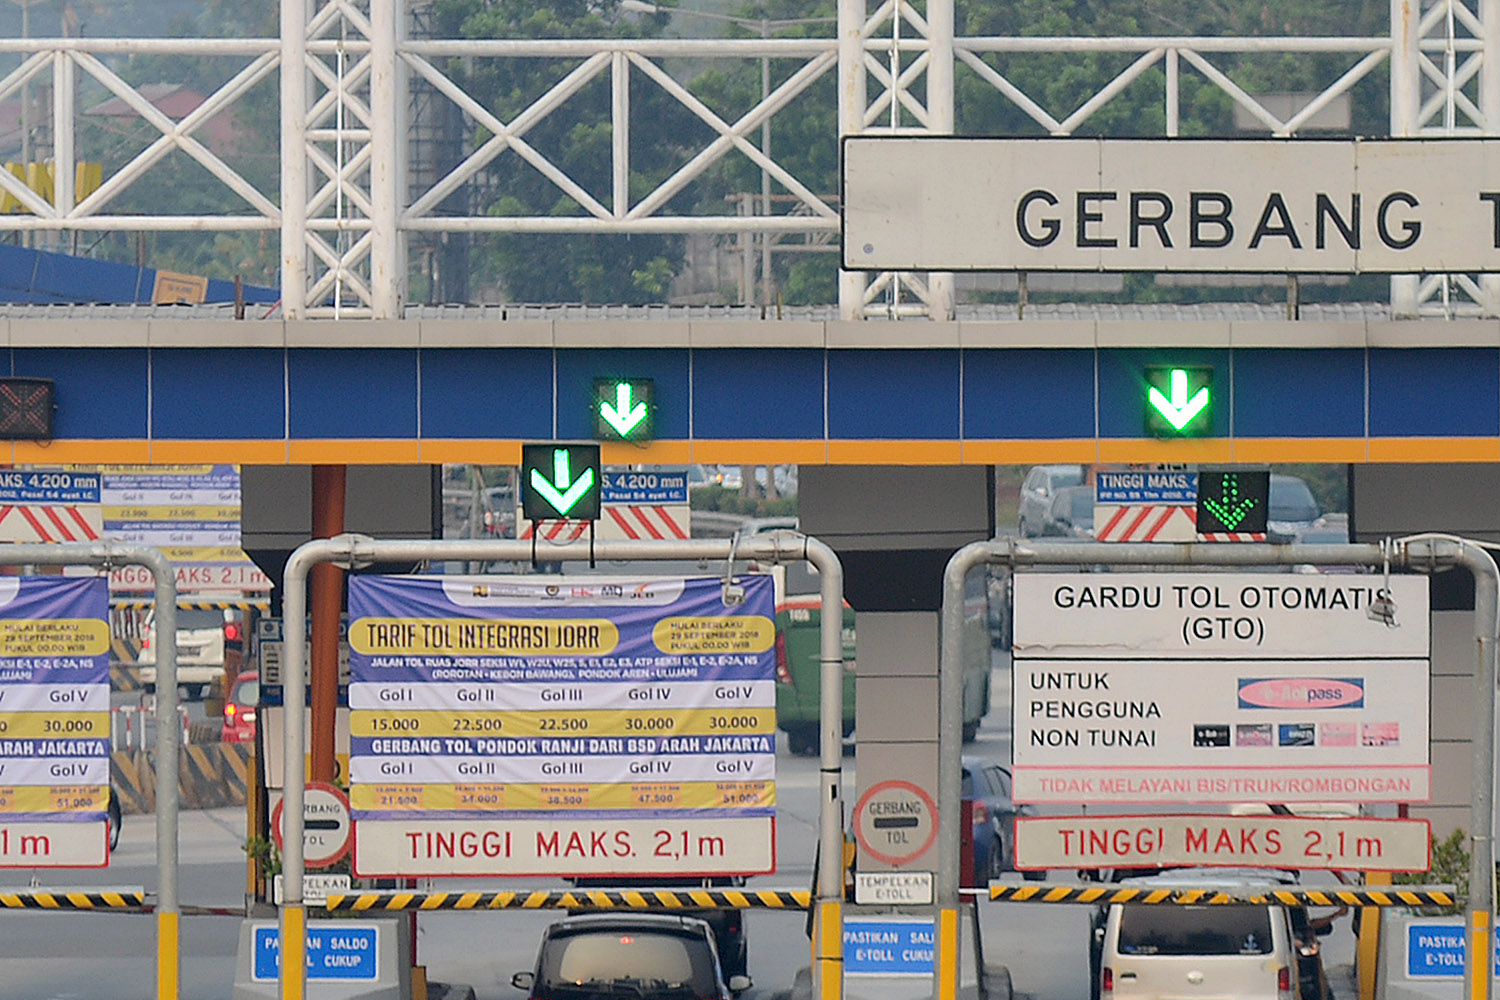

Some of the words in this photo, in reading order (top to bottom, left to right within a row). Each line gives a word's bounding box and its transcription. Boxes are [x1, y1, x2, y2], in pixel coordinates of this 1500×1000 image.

[1015, 188, 1423, 250] GERBANG
[29, 474, 71, 488] 4.200
[74, 478, 97, 488] mm
[616, 475, 657, 488] 4.200
[661, 477, 683, 488] mm
[1101, 475, 1144, 488] TINGGI
[175, 567, 214, 583] AKS.
[1053, 586, 1162, 610] GARDU
[1173, 586, 1230, 610] TOL
[367, 623, 416, 648] TARIF
[422, 624, 453, 648] TOL
[459, 624, 549, 649] INTEGRASI
[555, 625, 600, 648] JORR
[1182, 616, 1266, 645] (GTO)
[1030, 672, 1110, 690] UNTUK
[50, 690, 75, 702] Gol
[78, 691, 88, 702] V
[628, 688, 652, 700] Gol
[656, 688, 671, 700] IV
[715, 687, 739, 699] Gol
[742, 687, 753, 699] V
[1030, 701, 1162, 719] PENGGUNA
[43, 720, 93, 733] 30.000
[372, 718, 419, 730] 15.000
[453, 718, 502, 730] 22.500
[540, 718, 588, 730] 22.500
[625, 717, 674, 730] 30.000
[709, 716, 758, 728] 30.000
[1030, 729, 1083, 748] NON
[1087, 729, 1156, 748] TUNAI
[38, 741, 104, 755] JAKARTA
[372, 739, 441, 753] GERBANG
[446, 740, 473, 753] TOL
[477, 740, 537, 754] PONDOK
[542, 740, 584, 753] RANJI
[590, 739, 623, 752] DARI
[628, 739, 656, 752] BSD
[660, 738, 700, 752] ARAH
[704, 737, 770, 752] JAKARTA
[1040, 778, 1093, 793] TIDAK
[1101, 778, 1192, 793] MELAYANI
[1198, 777, 1411, 793] BIS/TRUK/ROMBONGAN
[869, 801, 922, 815] GERBANG
[886, 831, 909, 844] TOL
[20, 834, 50, 856] m
[406, 830, 512, 859] TINGGI
[536, 830, 636, 858] MAKS.
[653, 829, 690, 861] 2,1
[699, 838, 724, 856] m
[1059, 829, 1164, 856] TINGGI
[1185, 828, 1283, 856] MAKS
[1303, 831, 1344, 861] 2,1
[1357, 838, 1383, 857] m
[860, 876, 929, 887] TEMPELKAN
[331, 937, 368, 950] SALDO
[844, 931, 899, 943] PASTIKAN
[1419, 936, 1466, 948] PASTIKA
[324, 955, 362, 967] CUKUP
